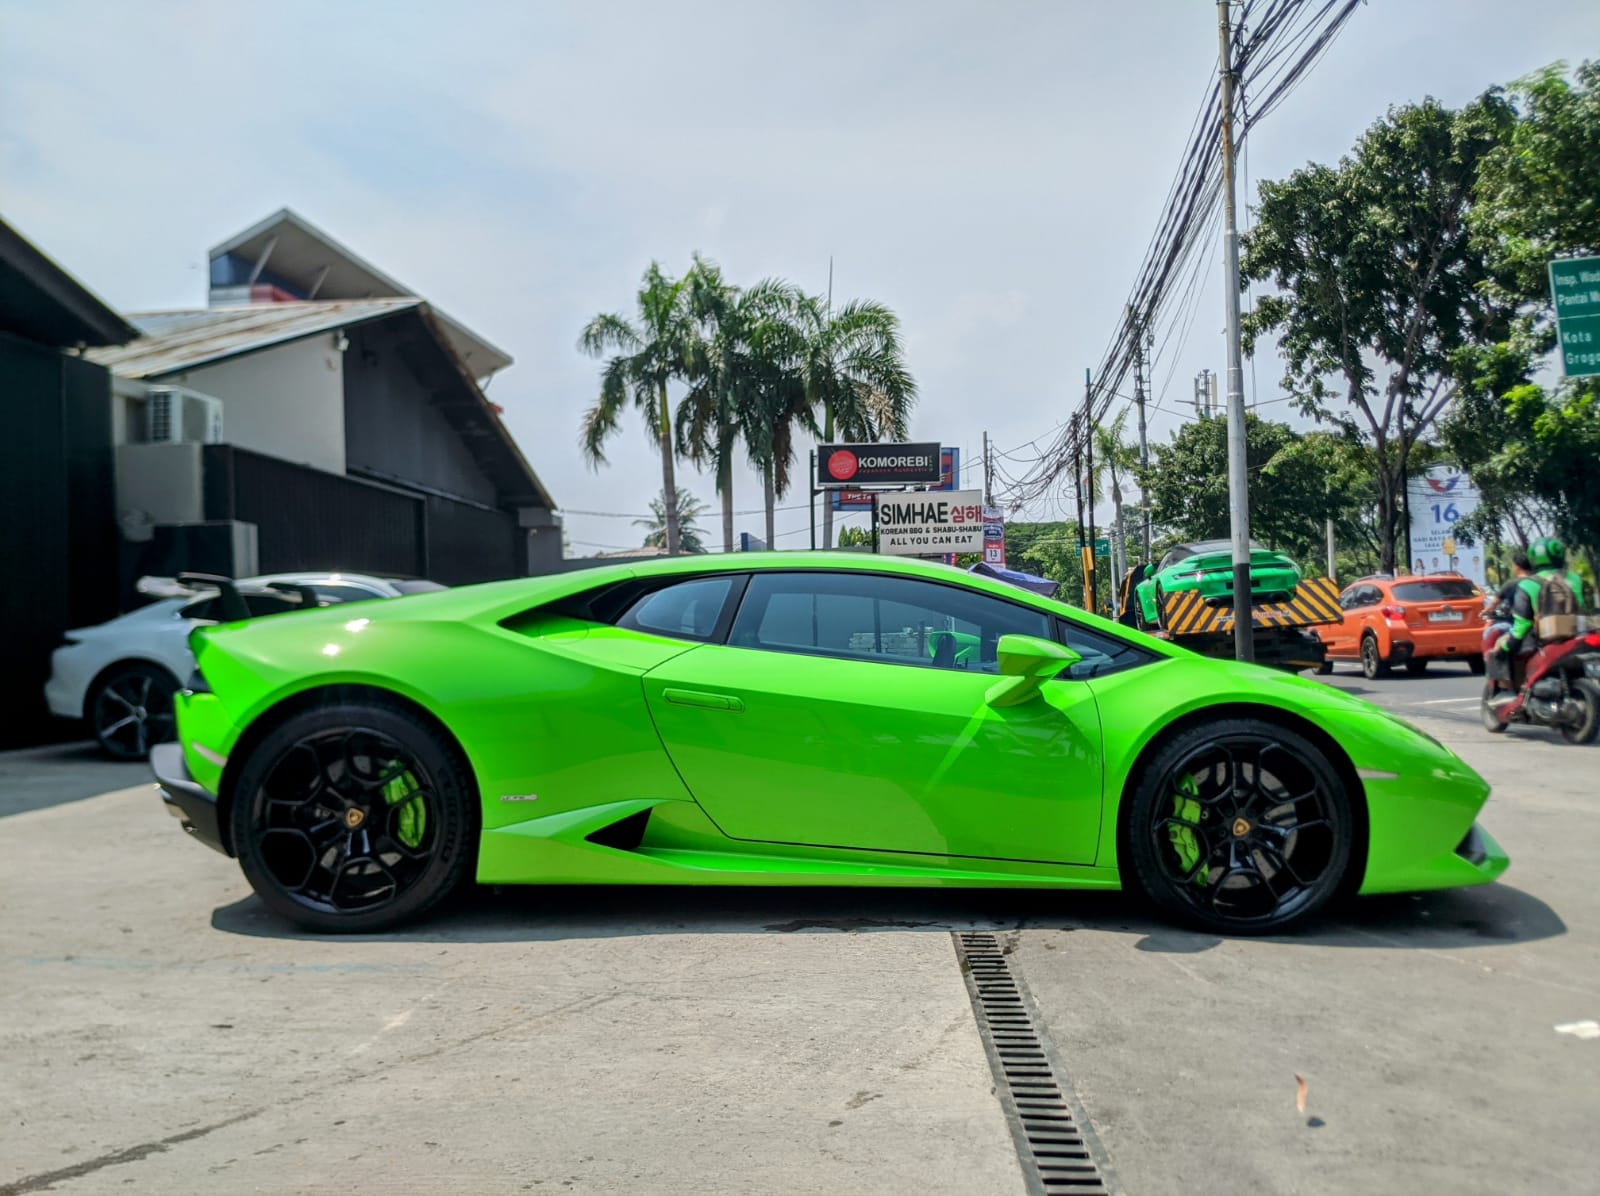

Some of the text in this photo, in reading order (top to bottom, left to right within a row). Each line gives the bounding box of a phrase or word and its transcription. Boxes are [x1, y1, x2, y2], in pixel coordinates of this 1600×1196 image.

[1562, 331, 1592, 344] Kota
[858, 456, 928, 468] KOMOREBI
[880, 502, 948, 525] SIMHAE
[950, 505, 982, 523] 심해
[1430, 503, 1459, 523] 16
[880, 527, 908, 535] KOREAN
[890, 535, 973, 546] ALL YOU CAN EAT
